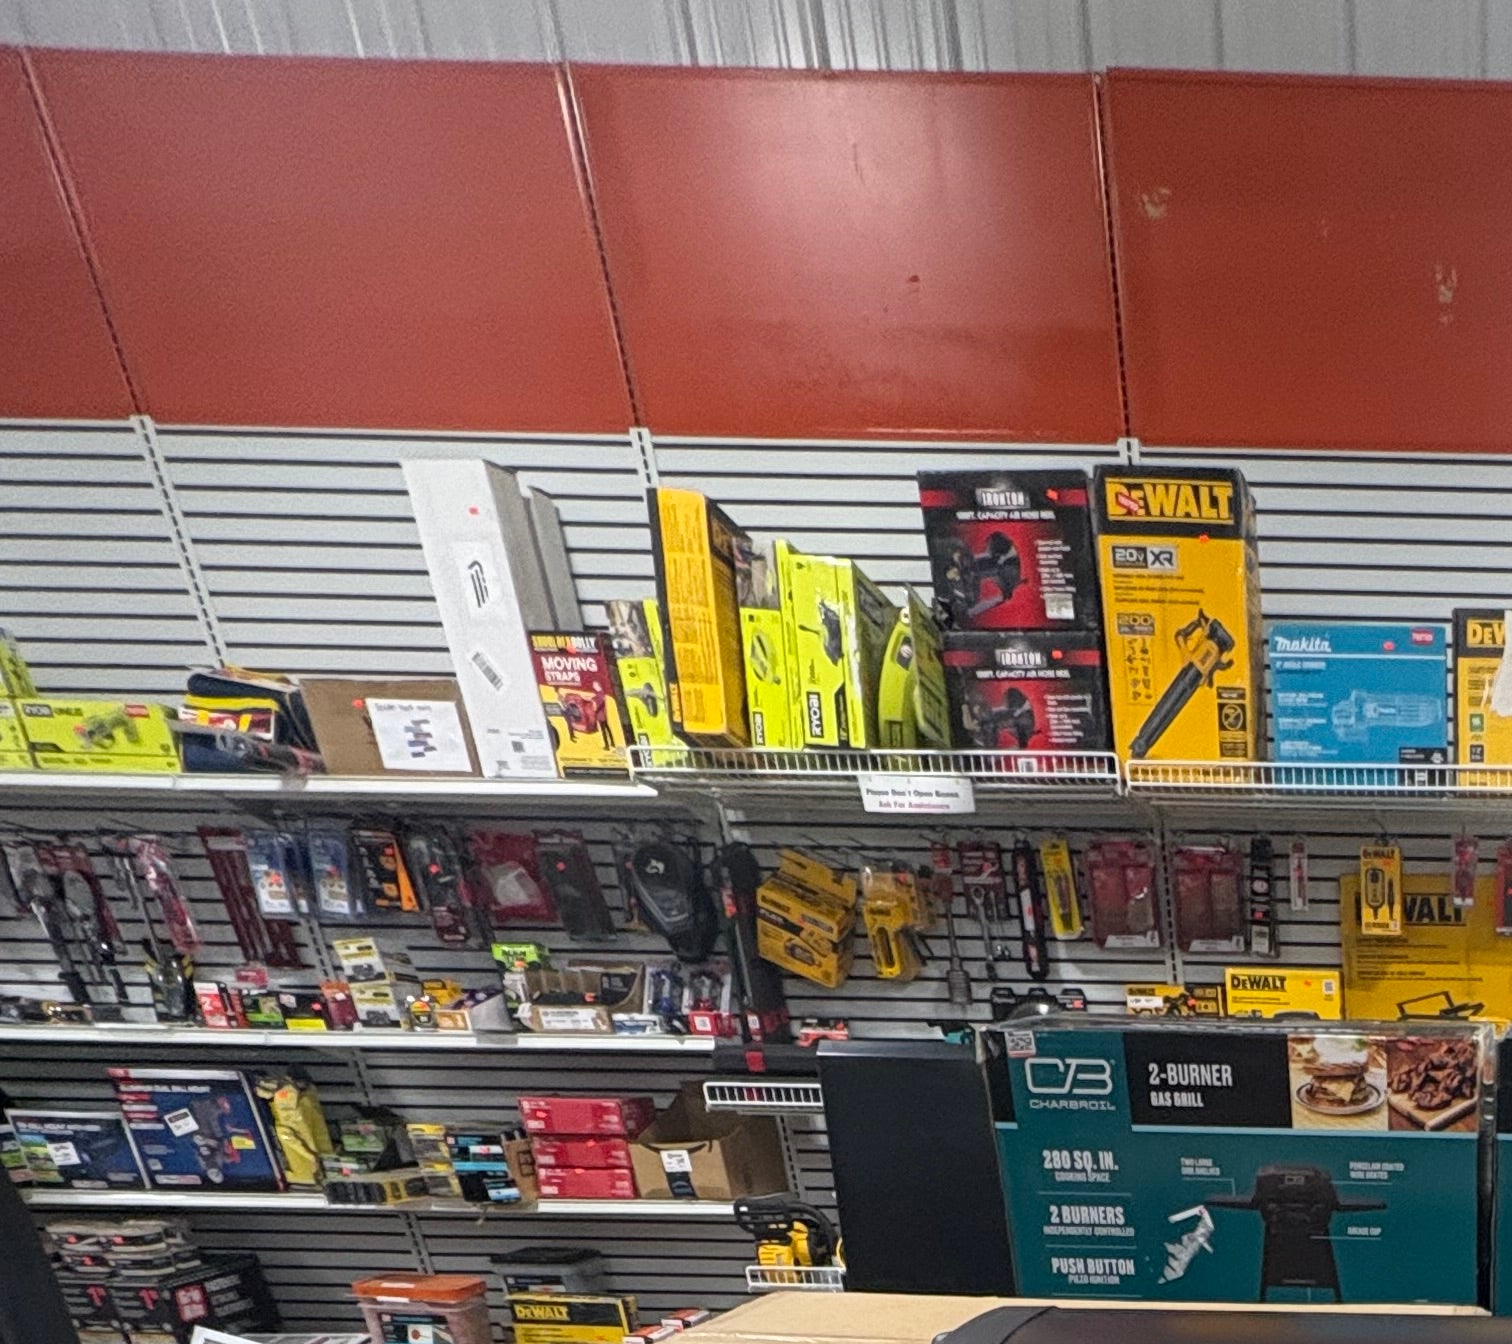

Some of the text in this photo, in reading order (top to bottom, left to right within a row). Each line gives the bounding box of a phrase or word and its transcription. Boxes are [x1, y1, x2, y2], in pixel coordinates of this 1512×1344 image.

[982, 491, 1024, 506] IRONTON
[1107, 482, 1233, 520] DEWALT
[1150, 550, 1173, 566] XR
[541, 656, 598, 672] MOVING
[1001, 652, 1042, 666] IRONTON
[544, 671, 581, 682] STRAPS
[808, 694, 824, 737] RYOBI
[754, 712, 764, 745] RYOBI
[913, 790, 933, 798] Open
[1231, 975, 1287, 991] DEWALT
[1148, 1063, 1233, 1087] 2-BURNER
[1029, 1099, 1117, 1111] CHARBROIL
[1150, 1091, 1204, 1107] GAS GRILL
[1042, 1150, 1119, 1174] 280 SQ. IN.
[1050, 1205, 1125, 1225] 2 BURNERS
[1051, 1257, 1135, 1276] PUSH BUTTON
[515, 1305, 570, 1320] DEWALT
